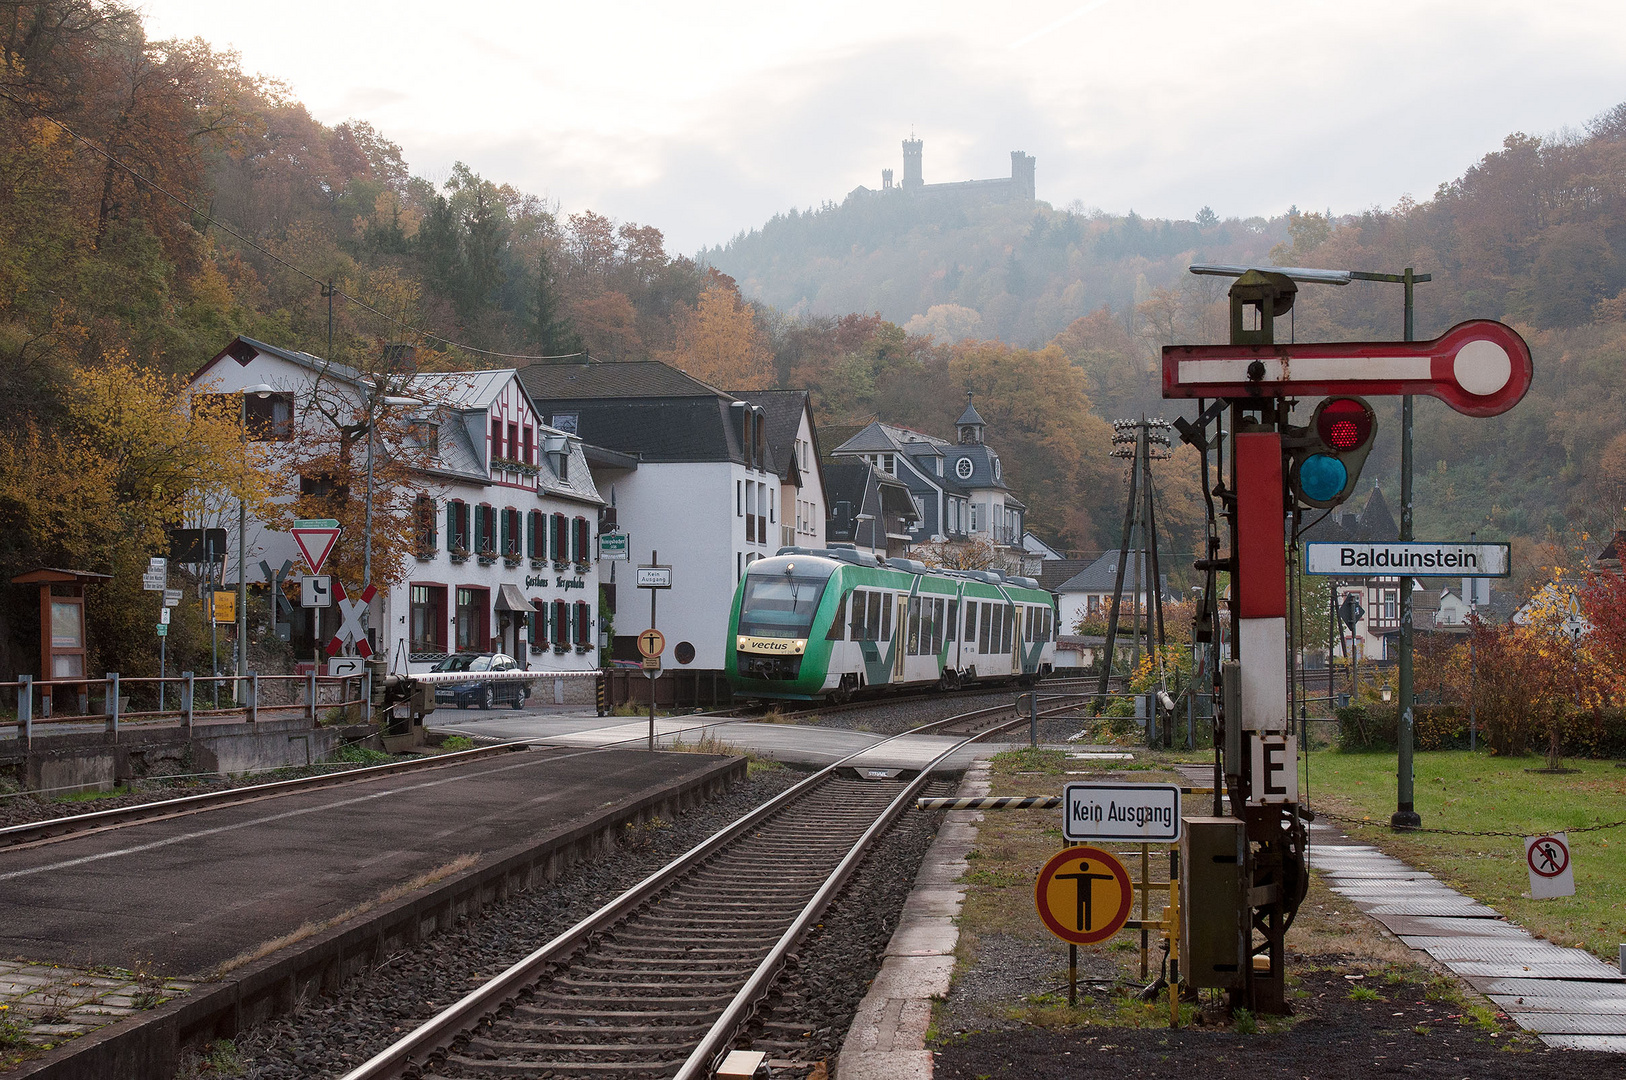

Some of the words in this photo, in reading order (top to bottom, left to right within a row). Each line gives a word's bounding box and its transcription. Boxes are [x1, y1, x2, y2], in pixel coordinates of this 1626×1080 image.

[1340, 548, 1477, 568] Balduinstein
[526, 574, 548, 590] Gasthaus
[752, 641, 788, 650] vectus
[1263, 743, 1286, 795] E
[1073, 800, 1102, 822] Kein
[1108, 800, 1172, 828] Ausgang
